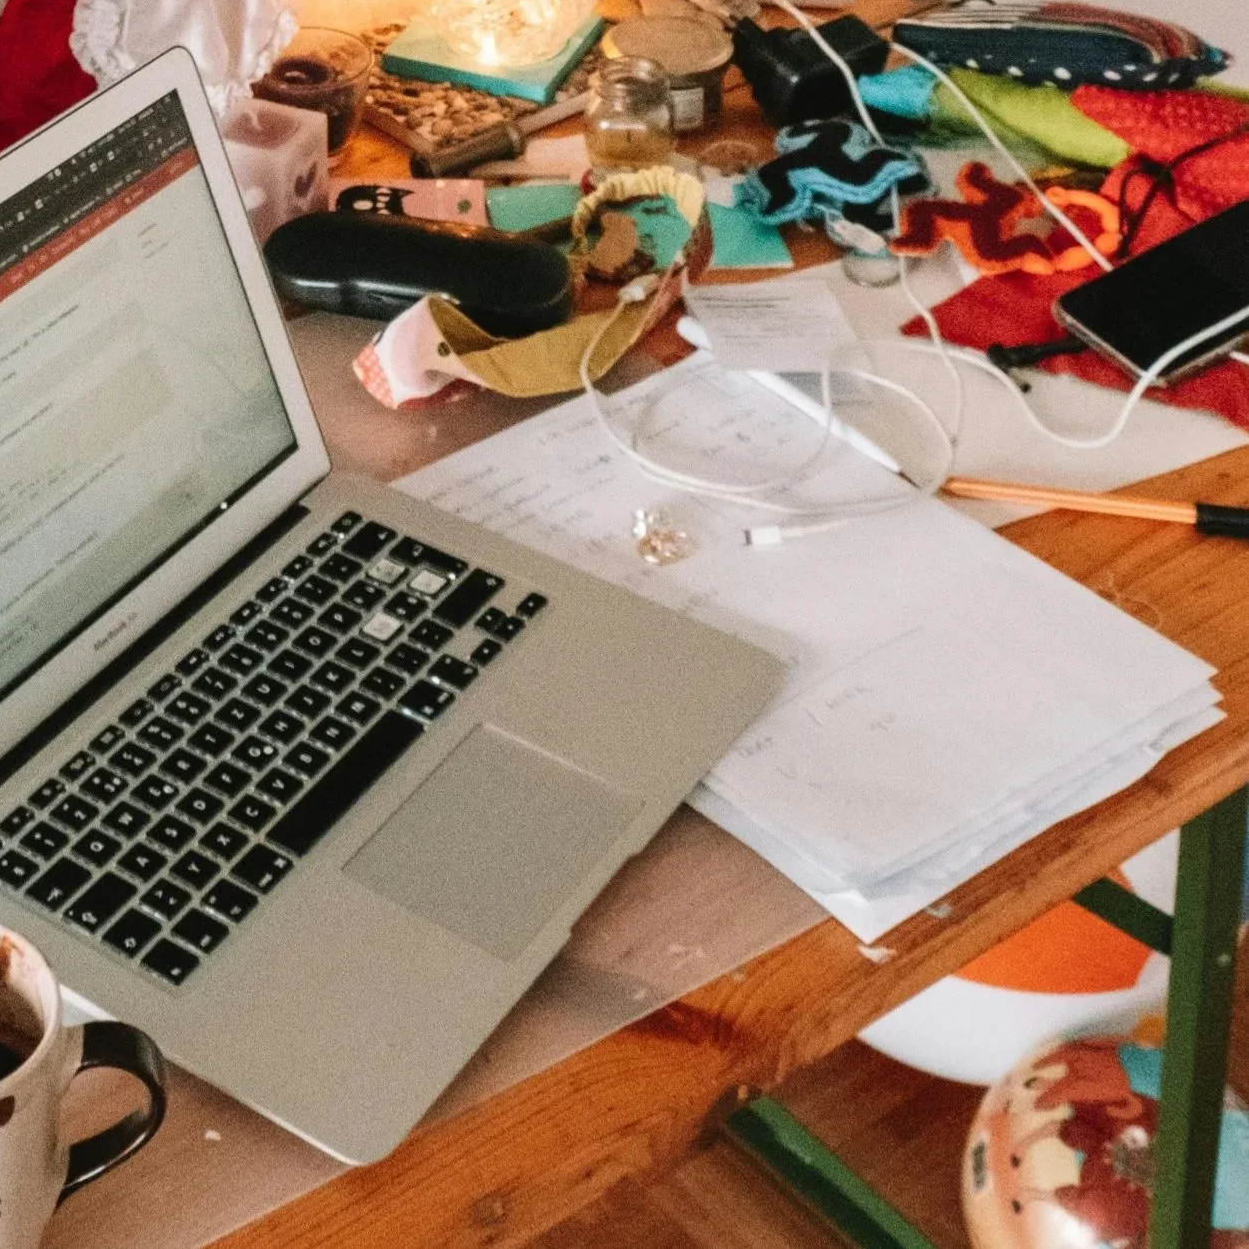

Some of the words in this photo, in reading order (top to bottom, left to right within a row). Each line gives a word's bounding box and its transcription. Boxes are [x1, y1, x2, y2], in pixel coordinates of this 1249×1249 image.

[89, 842, 105, 851] Q
[118, 813, 134, 825] W
[148, 787, 162, 796] E
[204, 733, 216, 743] T
[231, 709, 245, 719] Z
[257, 684, 271, 693] U
[308, 636, 322, 645] O
[333, 613, 344, 622] P
[135, 857, 149, 867] A
[164, 828, 178, 837] S
[274, 721, 288, 731] H
[326, 672, 339, 681] K
[351, 649, 365, 658] L
[187, 863, 200, 872] Y
[217, 835, 231, 845] X
[245, 807, 259, 816] C
[272, 779, 285, 789] V
[325, 727, 340, 737] N
